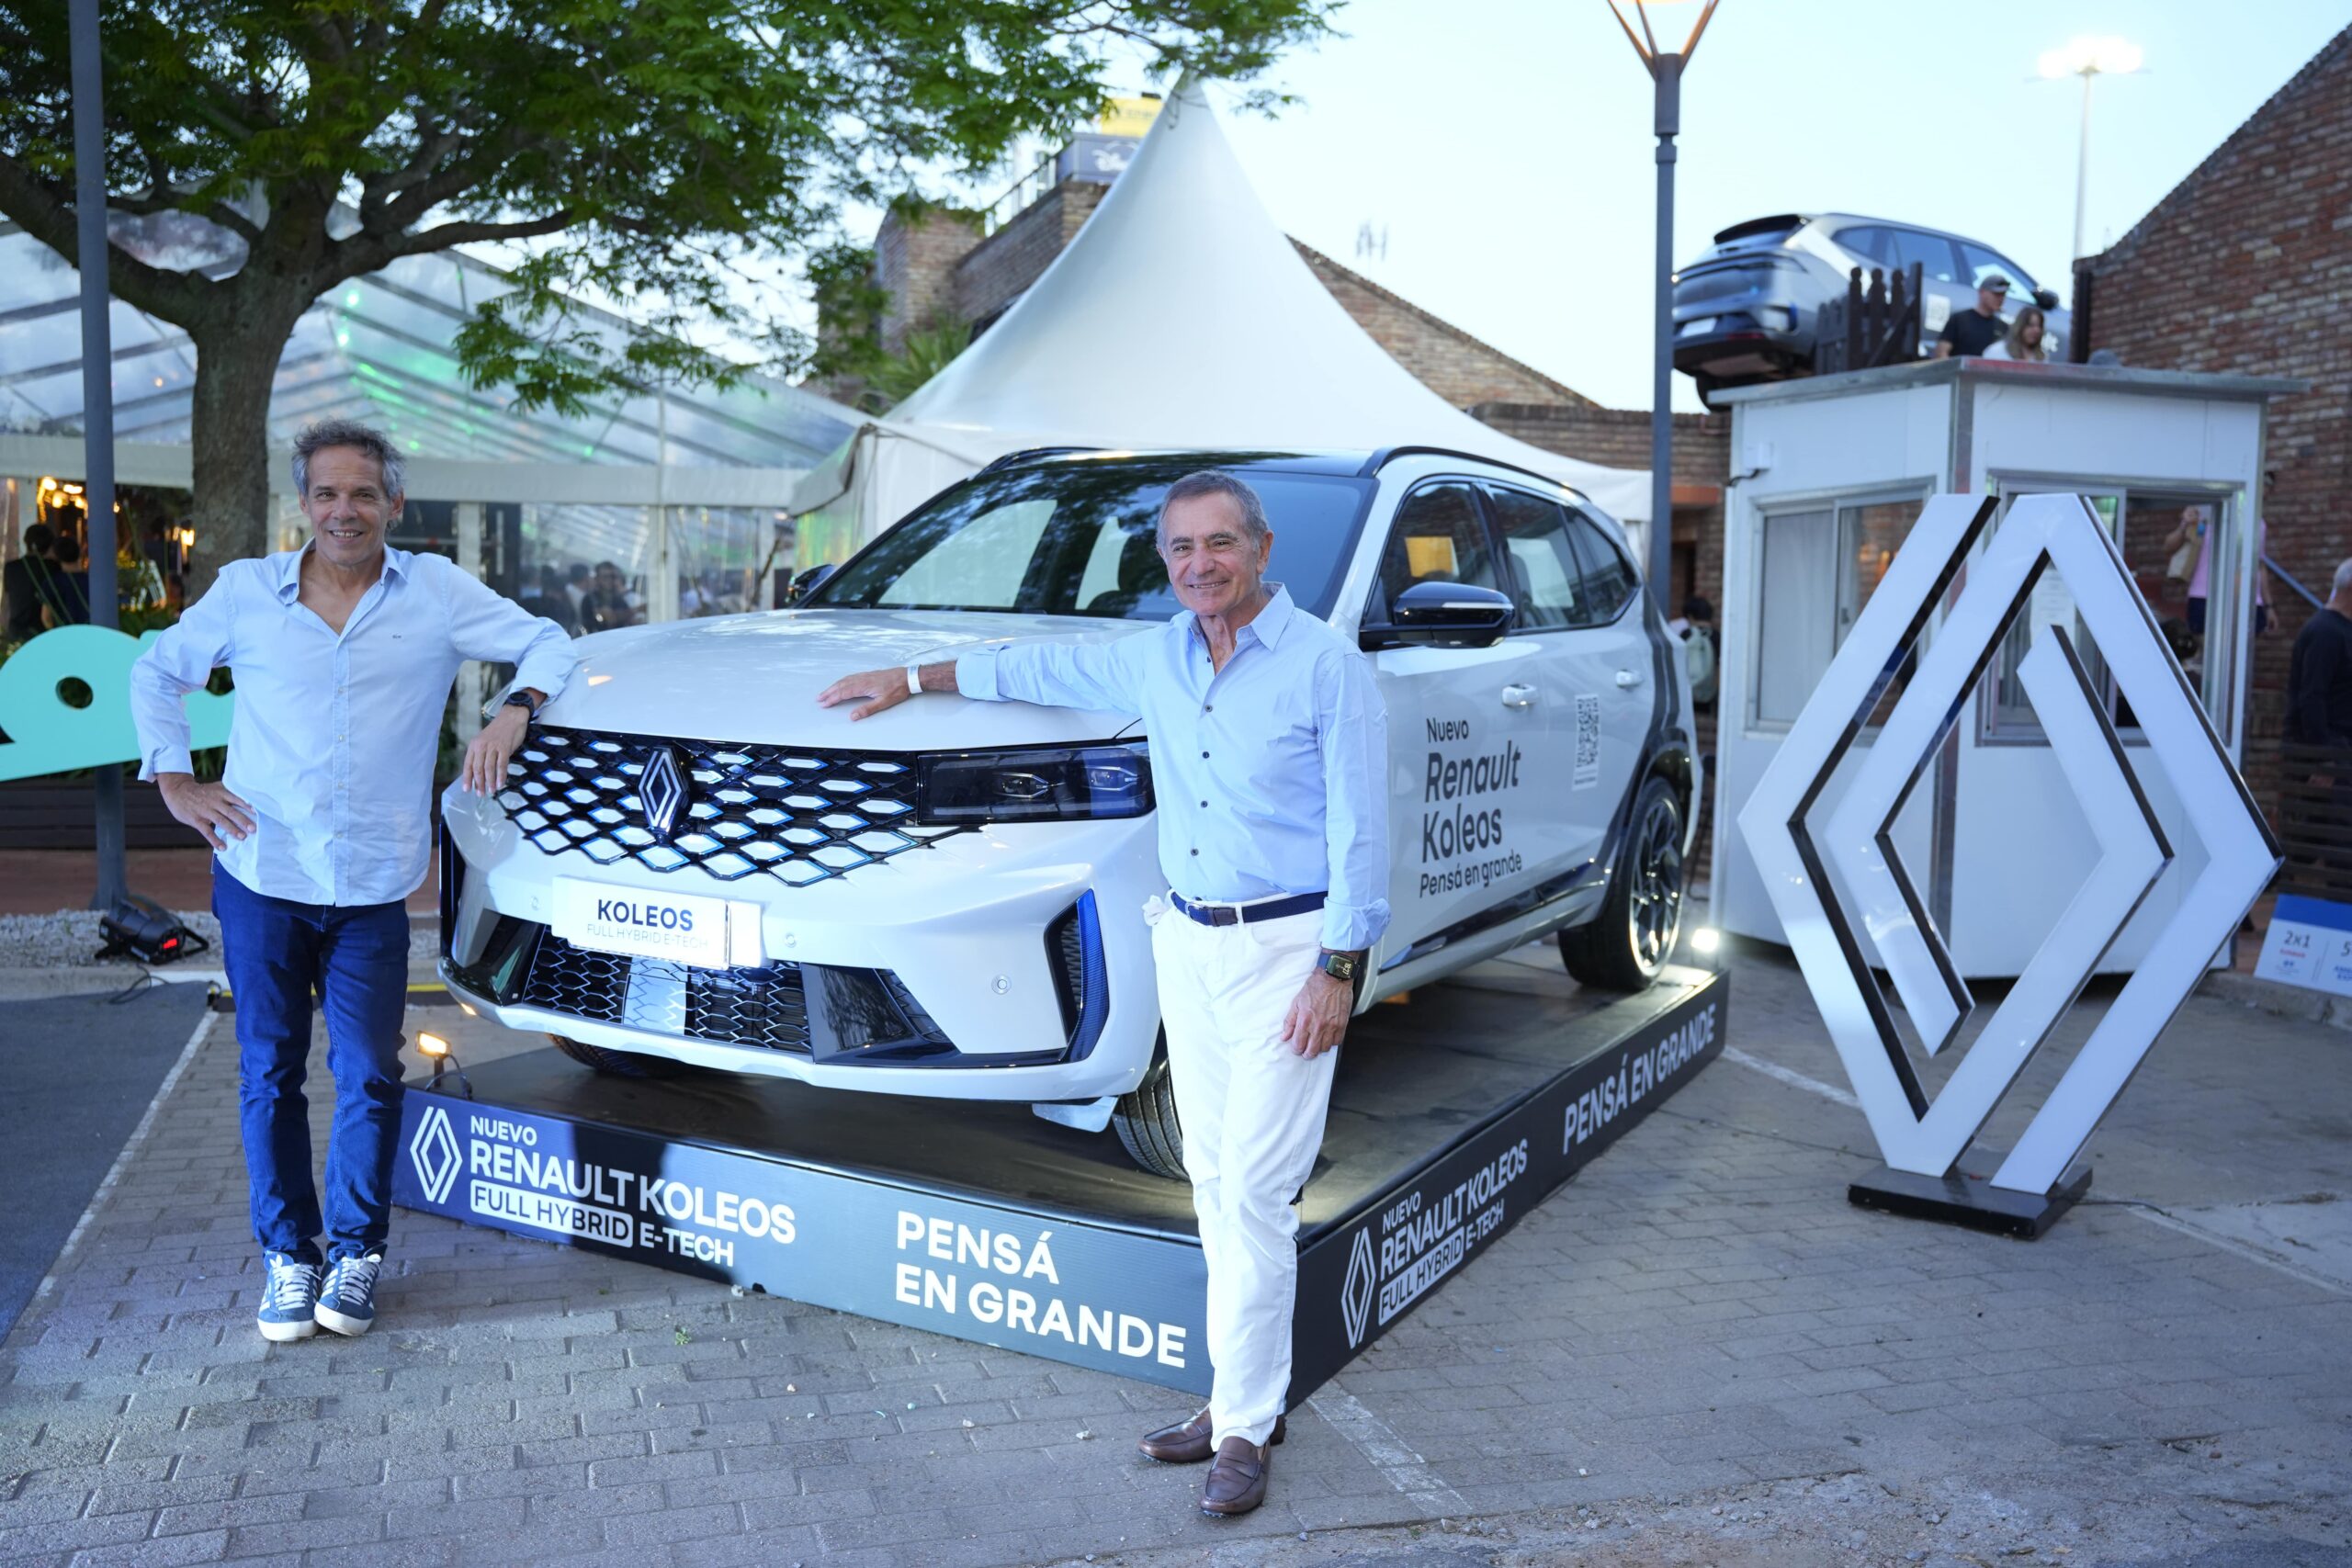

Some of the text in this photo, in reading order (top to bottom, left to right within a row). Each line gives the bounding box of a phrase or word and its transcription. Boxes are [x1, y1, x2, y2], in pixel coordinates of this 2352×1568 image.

[1427, 717, 1469, 743] Nuevo
[1425, 739, 1521, 803] Renault
[1422, 803, 1502, 863] Koleos
[1419, 849, 1522, 898] Pensá en grande
[587, 923, 708, 949] FULL HYBRID E-TECH
[597, 898, 694, 931] KOLEOS
[1563, 1002, 1716, 1156] PENSÁ EN GRANDE
[470, 1114, 537, 1146] NUEVO
[470, 1139, 797, 1245] RENAULT KOLEOS
[1380, 1138, 1529, 1282] RENAULT KOLEOS
[1382, 1190, 1421, 1235] NUEVO
[473, 1184, 734, 1268] FULL HYBRID E-TECH
[897, 1211, 1060, 1285] PENSÁ
[1381, 1198, 1505, 1319] FULL HYBRID E-TECH
[896, 1262, 1187, 1369] EN GRANDE
